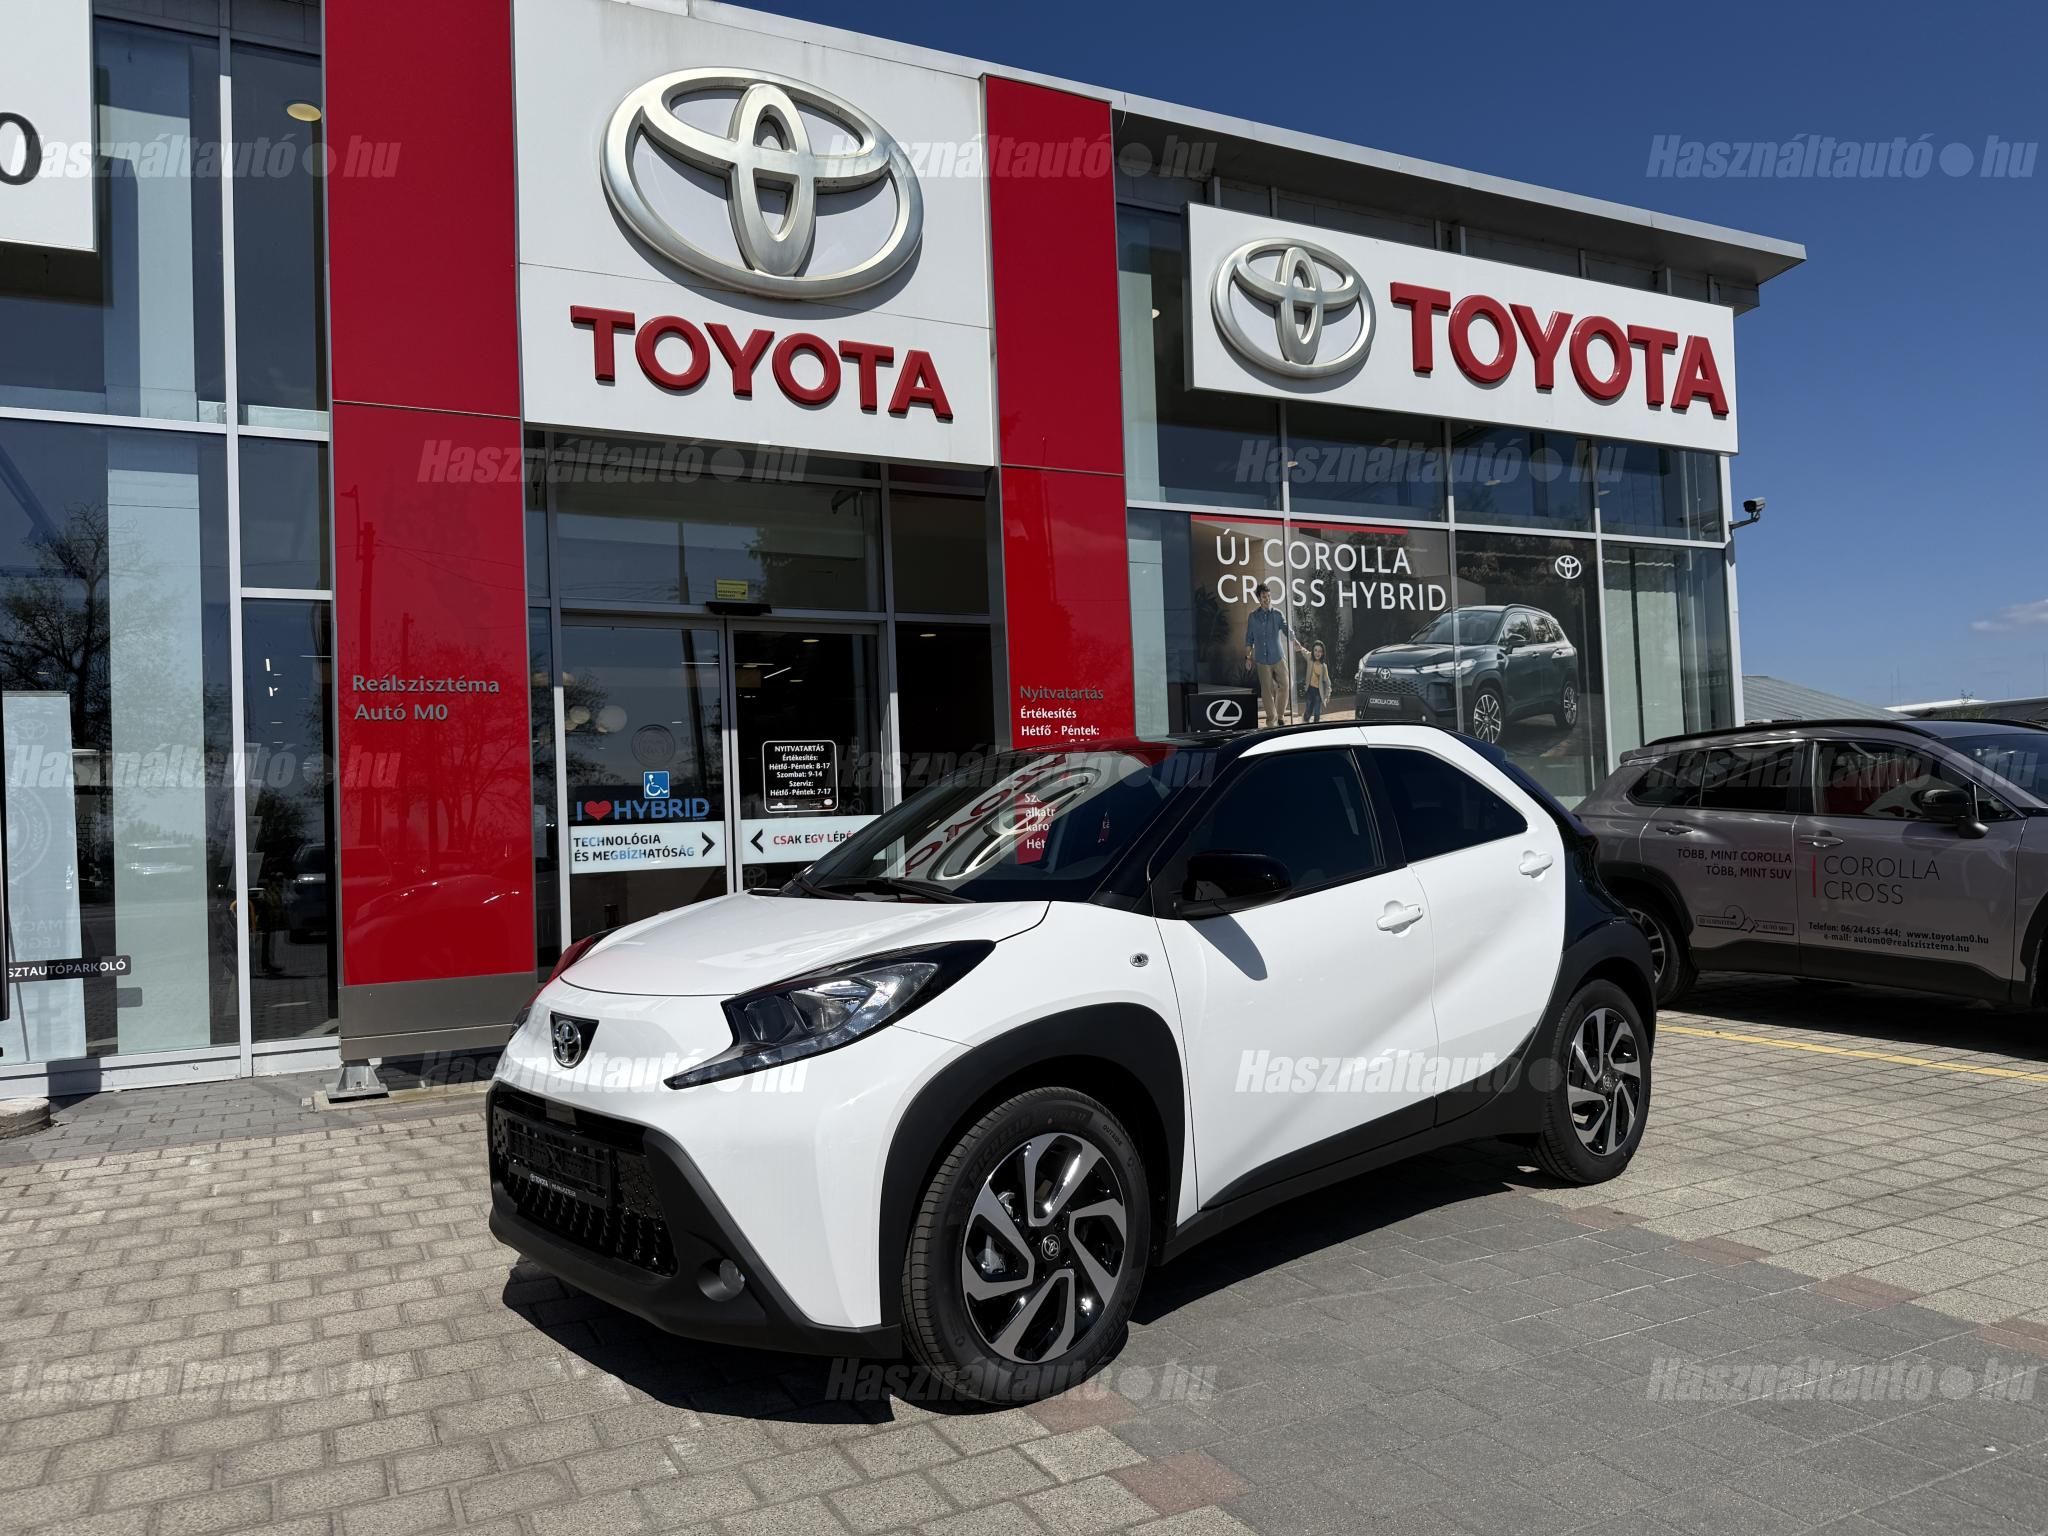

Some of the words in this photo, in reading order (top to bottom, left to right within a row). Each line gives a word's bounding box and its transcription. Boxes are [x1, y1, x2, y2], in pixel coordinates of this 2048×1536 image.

[1390, 281, 1731, 418] TOYOTA
[570, 304, 954, 421] TOYOTA
[1216, 528, 1251, 567] ÚJ
[1264, 540, 1412, 576] COROLLA
[1217, 574, 1326, 608] CROSS
[1338, 580, 1447, 612] HYBRID
[352, 673, 500, 693] Reálszisztéma
[1019, 685, 1105, 703] Nyitvatartás
[354, 703, 407, 721] Autó
[1020, 705, 1077, 719] Értékesítés
[1021, 725, 1052, 736] Hétfő
[1061, 724, 1100, 736] Péntek:
[774, 744, 825, 753] NYITVATARTÁS
[782, 754, 819, 762] Értékesítés:
[815, 762, 831, 770] 8-17
[808, 770, 823, 778] 9-14
[788, 780, 814, 788] Szerviz:
[613, 797, 710, 820] HYBRID
[1026, 822, 1052, 832] karo
[573, 833, 661, 847] TECHNOLÓGIA
[773, 835, 802, 845] CSAK
[805, 834, 825, 844] EGY
[827, 830, 856, 843] LÉPÉ
[574, 850, 589, 861] ÉS
[592, 845, 695, 861] MEGBÍZHATÓSÁG
[1677, 847, 1707, 862] TÖBB,
[1710, 849, 1738, 862] MINT
[1740, 851, 1792, 863] COROLLA
[1705, 863, 1737, 878] TÖBB,
[1740, 866, 1767, 878] MINT
[1769, 867, 1792, 880] SUV
[1823, 855, 1941, 881] COROLLA
[1823, 880, 1905, 905] CROSS
[1808, 921, 1839, 932] Telefon:
